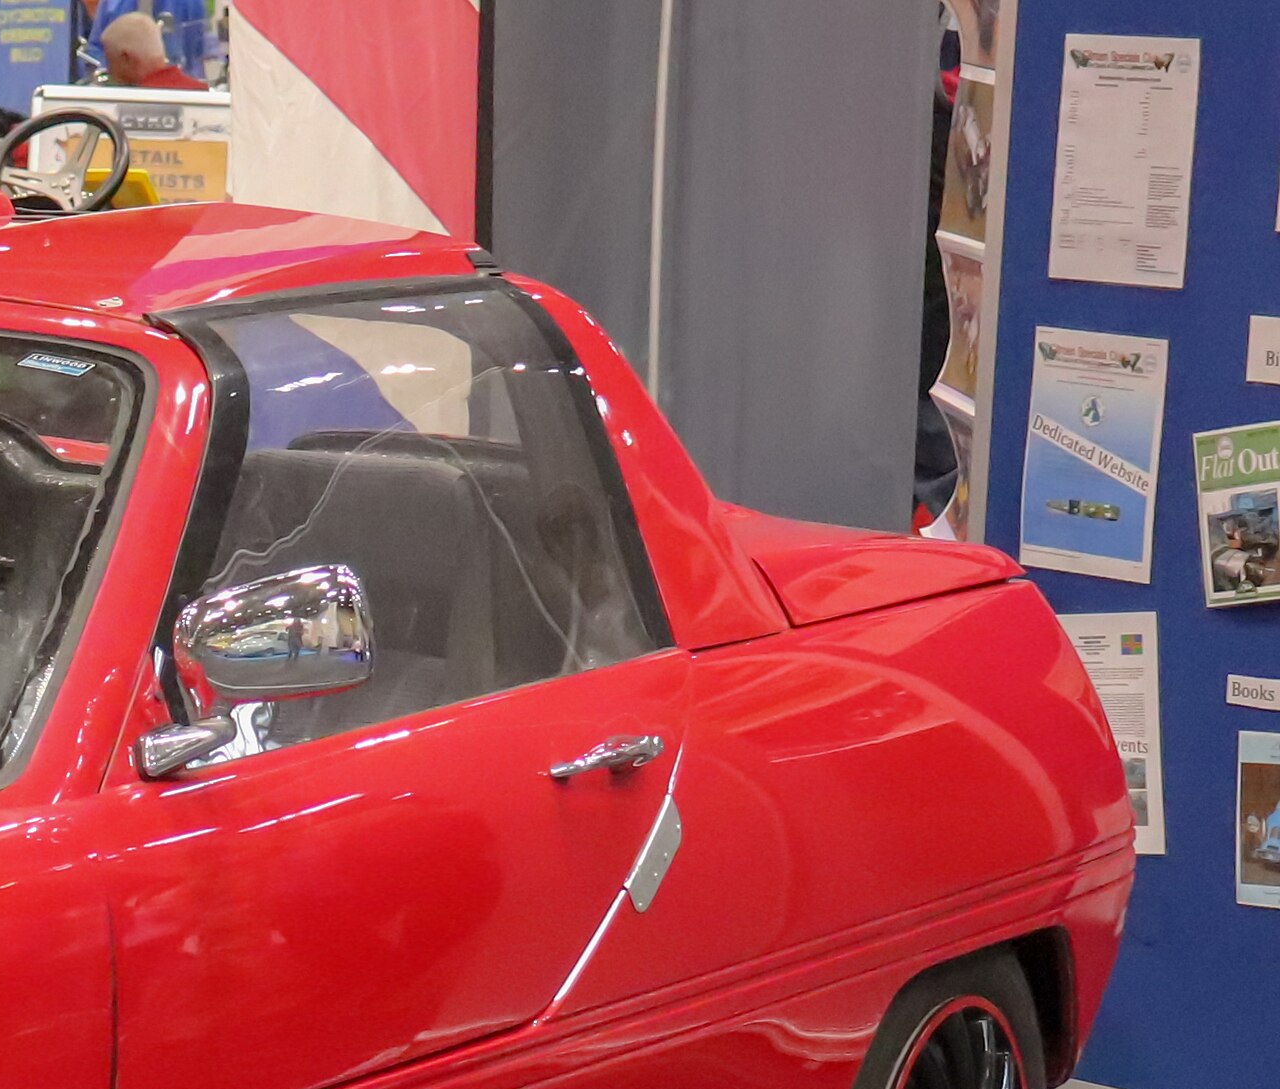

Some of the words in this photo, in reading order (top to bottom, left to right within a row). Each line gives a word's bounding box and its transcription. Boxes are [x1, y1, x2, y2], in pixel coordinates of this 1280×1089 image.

[129, 149, 183, 165] ETAIL
[1032, 414, 1096, 460] Dedicated
[1098, 450, 1149, 492] Website
[1237, 447, 1280, 475] Out
[1231, 681, 1276, 702] Books
